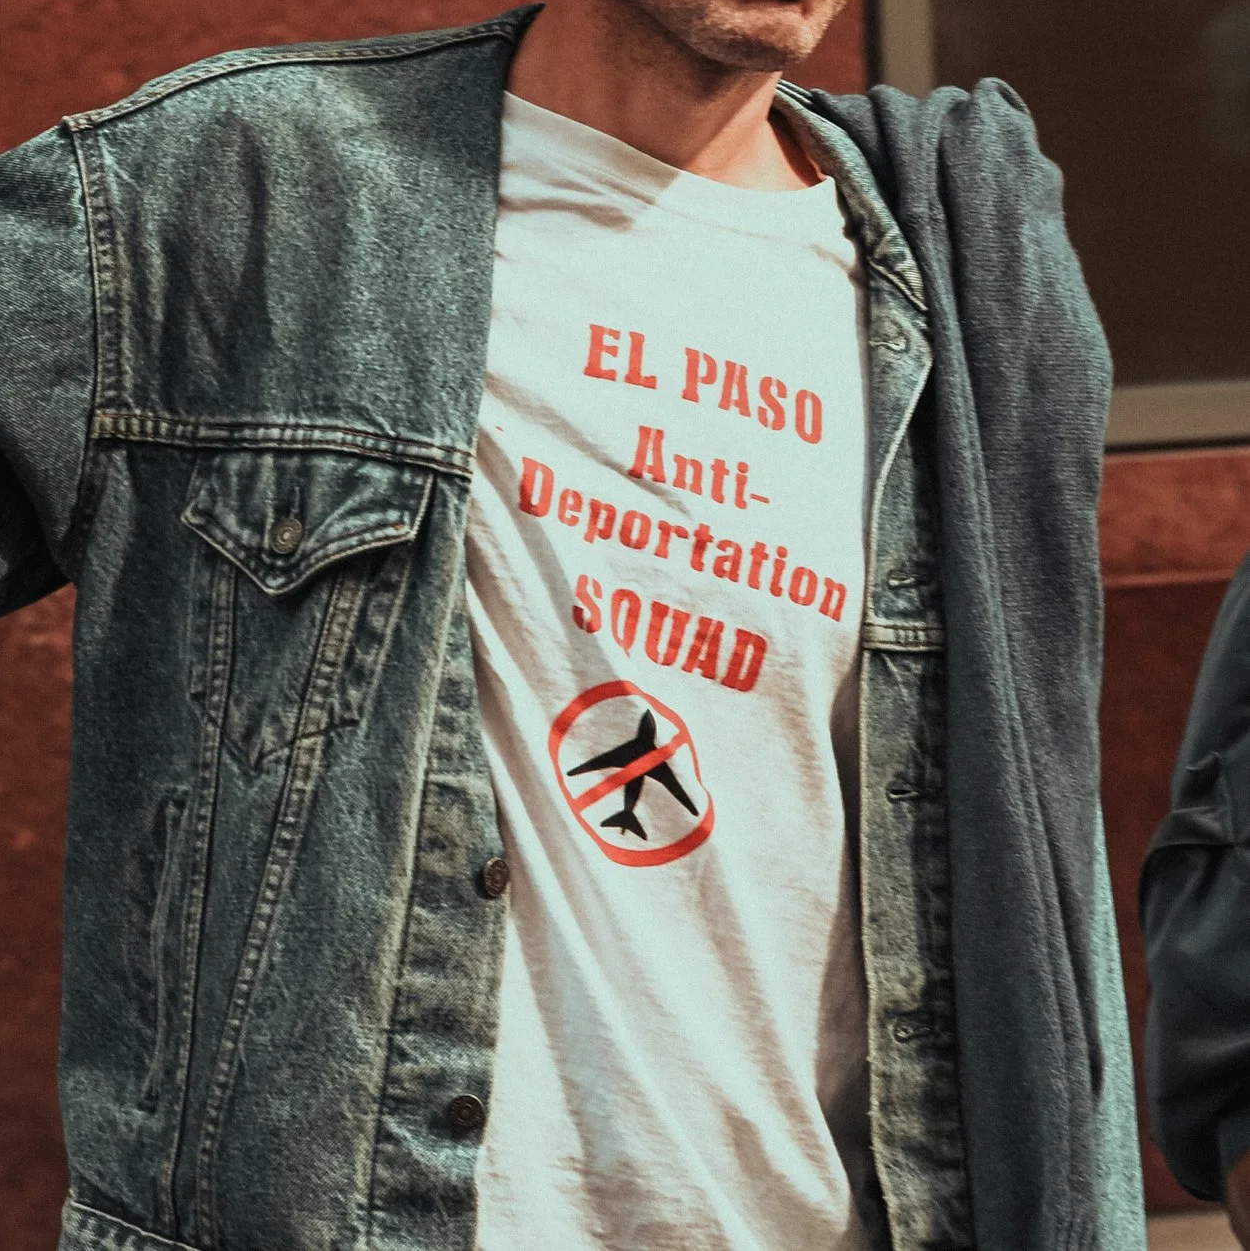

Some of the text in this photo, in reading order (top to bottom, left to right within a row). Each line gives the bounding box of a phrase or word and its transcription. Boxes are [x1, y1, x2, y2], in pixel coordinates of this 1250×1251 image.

[583, 324, 823, 444] EL PASO
[628, 425, 770, 509] Anti-
[518, 456, 847, 622] Deportation
[572, 573, 768, 693] SQUAD
